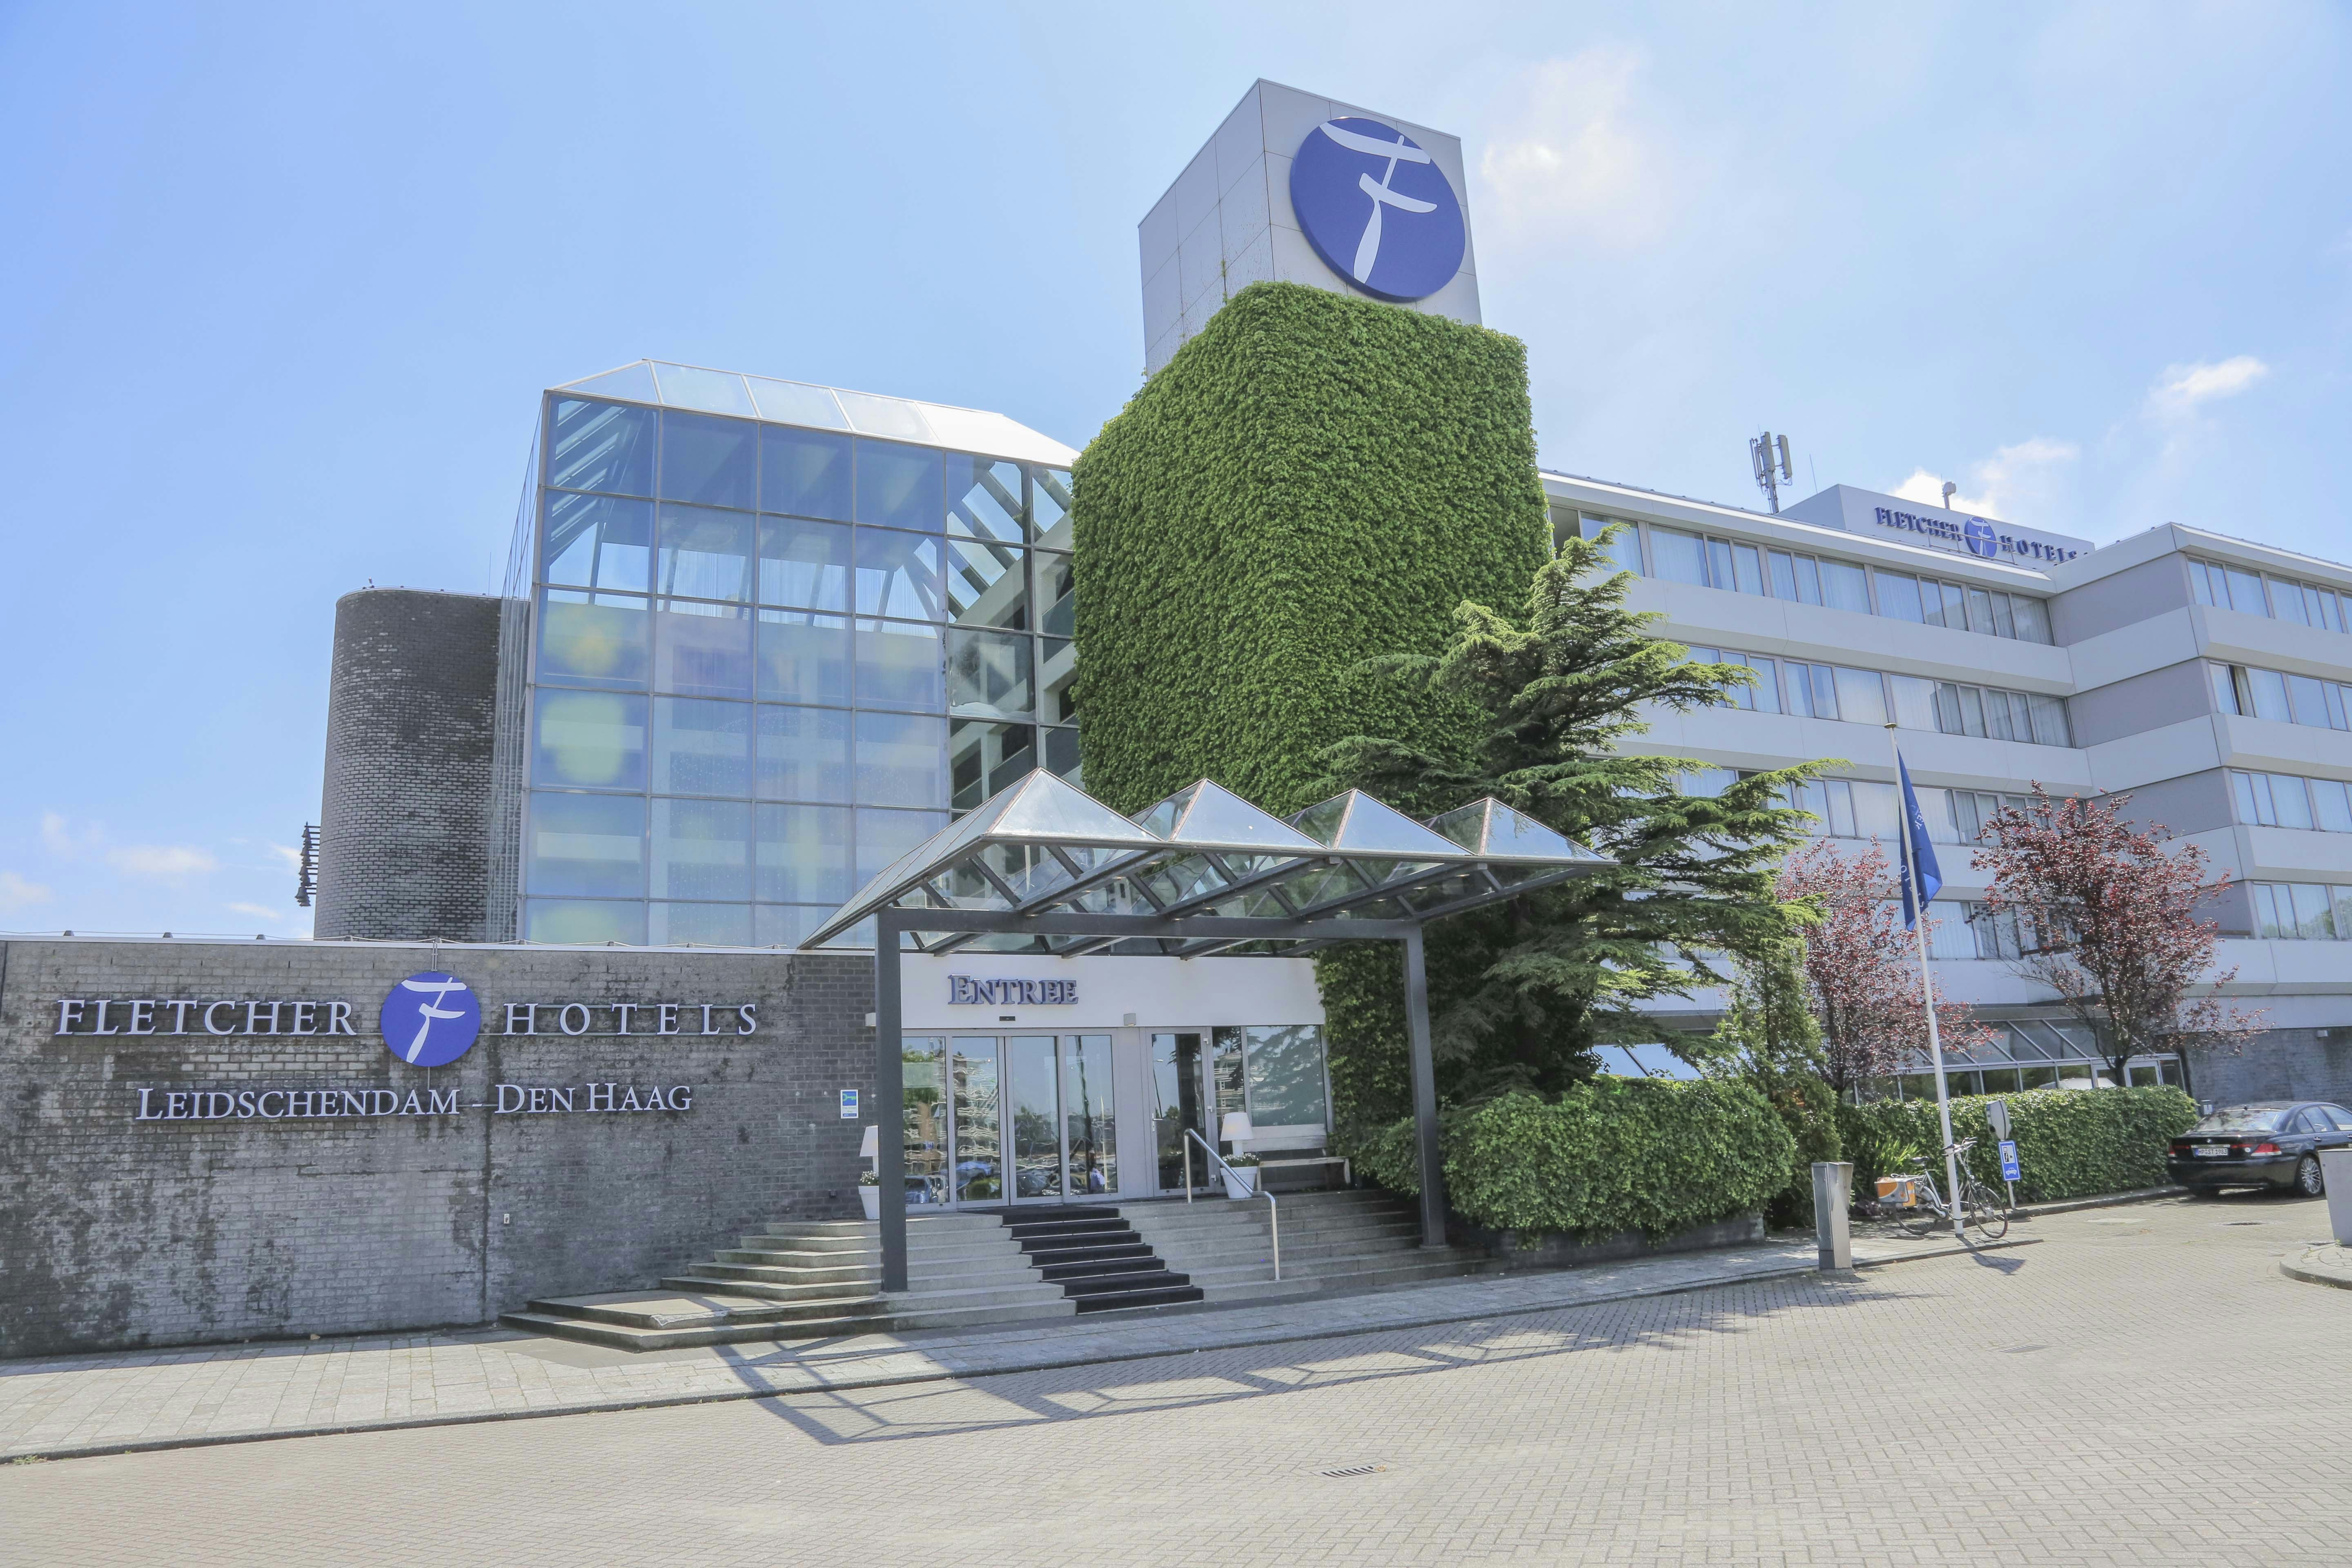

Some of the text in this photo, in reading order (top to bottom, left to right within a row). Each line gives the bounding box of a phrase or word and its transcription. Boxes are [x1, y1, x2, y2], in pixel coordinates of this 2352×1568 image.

[1874, 506, 1963, 541] FLETCHER
[947, 973, 1079, 1005] ENTREE
[55, 999, 357, 1036] FLETCHER
[503, 1002, 757, 1036] HOTELS
[136, 1088, 460, 1120] LEIDSCHENDAM
[494, 1084, 576, 1114] DEN
[586, 1082, 693, 1112] HAAG
